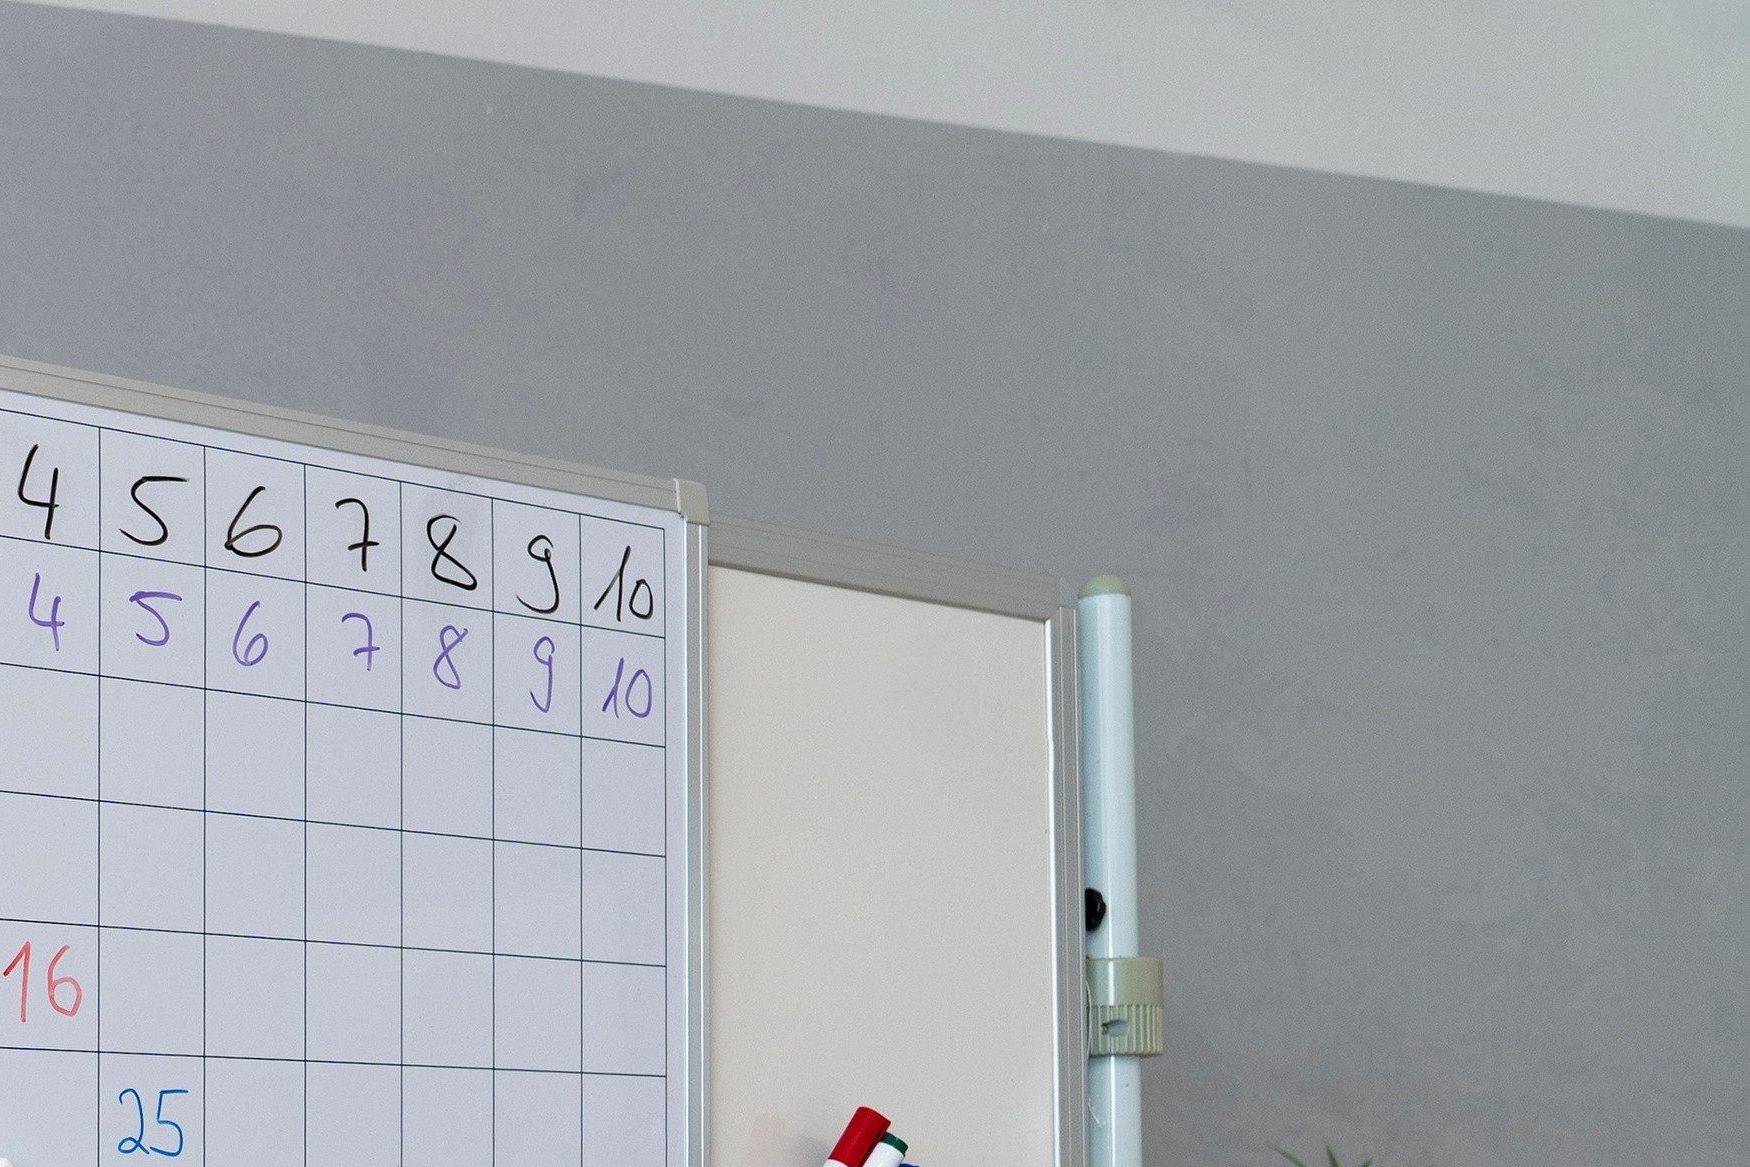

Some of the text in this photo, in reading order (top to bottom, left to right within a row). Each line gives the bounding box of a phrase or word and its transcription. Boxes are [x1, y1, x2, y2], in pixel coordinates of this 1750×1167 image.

[18, 444, 60, 539] 4
[120, 475, 190, 546] 5
[224, 486, 283, 557] 6
[335, 498, 379, 571] 7
[426, 514, 478, 590] 8
[516, 534, 560, 613] 9
[594, 545, 653, 621] 10
[29, 573, 64, 651] 4
[129, 590, 182, 647] 5
[233, 601, 269, 666] 6
[341, 612, 380, 671] 7
[435, 625, 468, 689] 8
[530, 636, 554, 712] 9
[602, 657, 652, 719] 10
[3, 941, 83, 1023] 16
[117, 1088, 189, 1157] 25
